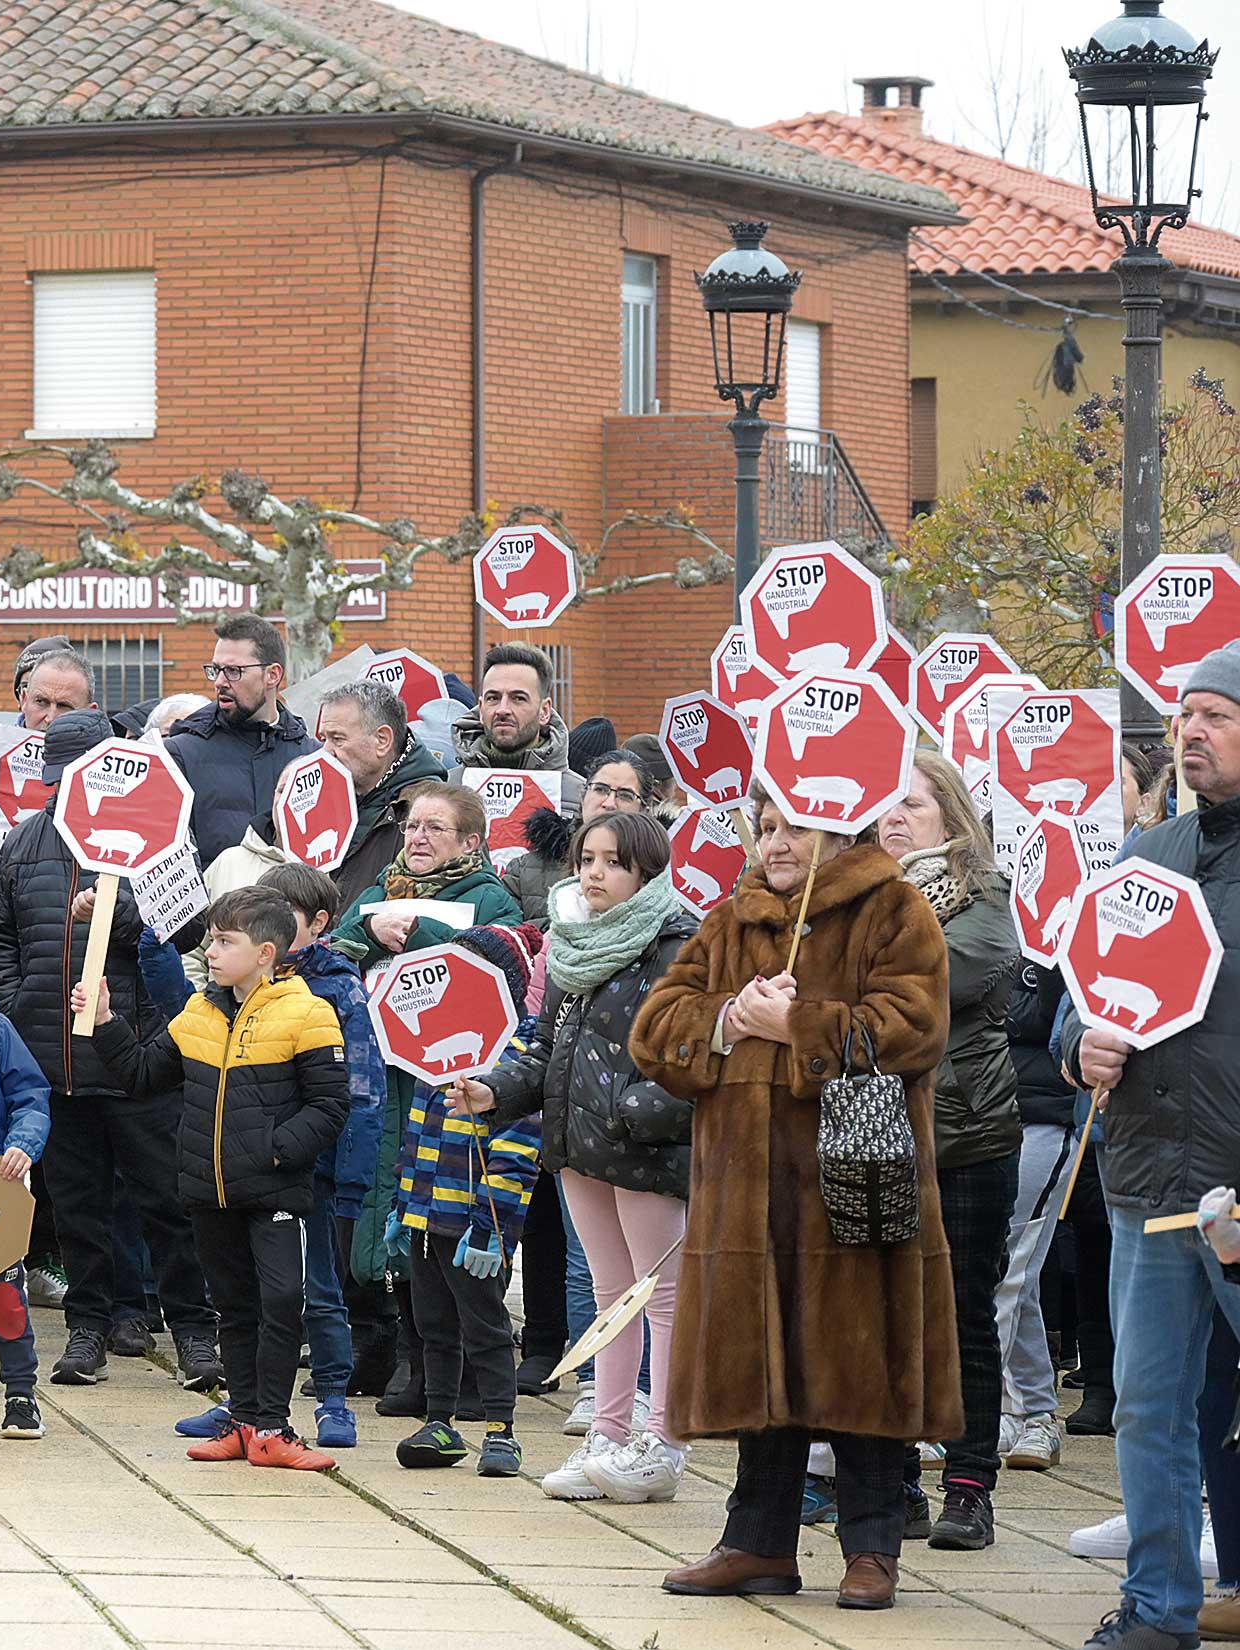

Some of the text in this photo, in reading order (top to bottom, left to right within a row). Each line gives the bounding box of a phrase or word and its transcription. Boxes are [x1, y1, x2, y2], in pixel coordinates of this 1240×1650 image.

[498, 540, 534, 554] STOP
[776, 564, 824, 588] STOP
[158, 576, 244, 609] DICO
[765, 586, 807, 600] GANADERÍA
[1158, 578, 1212, 597] STOP
[766, 598, 810, 612] INDUSTRIAL
[1144, 598, 1190, 608] GANADERÍA
[1144, 610, 1190, 621] INDUSTRIAL
[731, 641, 746, 655] ST
[940, 649, 978, 664] STOP
[370, 665, 404, 682] STOP
[930, 664, 962, 672] GANADERÍA
[930, 673, 962, 681] INDUSTRIAL
[804, 686, 859, 712] STOP
[674, 708, 706, 730] STOP
[788, 706, 834, 722] GANADERÍA
[1024, 705, 1070, 722] STOP
[672, 724, 700, 740] GANADERÍA
[786, 718, 834, 735] INDUSTRIAL
[1012, 723, 1052, 734] GANADERÍA
[676, 734, 704, 749] INDUSTRIAL
[1012, 734, 1054, 744] INDUSTRIAL
[24, 743, 44, 758] ST
[102, 756, 148, 778] STOP
[88, 771, 126, 785] GANADERÍA
[296, 768, 321, 793] STOP
[86, 782, 124, 796] INDUSTRIAL
[486, 782, 522, 798] STOP
[291, 790, 314, 806] GANADERÍA
[292, 799, 316, 814] INDUSTRIAL
[1022, 835, 1044, 875] STOP
[156, 884, 168, 898] EL
[167, 868, 188, 888] ORO.
[147, 877, 202, 927] EL AGUA ES EL
[1120, 880, 1174, 916] STOP
[165, 902, 195, 932] TESORO
[1102, 897, 1146, 922] GANADERÍA
[1099, 909, 1143, 936] INDUSTRIAL
[399, 965, 447, 990] STOP
[392, 986, 434, 1003] GANADERÍA
[395, 996, 438, 1013] INDUSTRIAL
